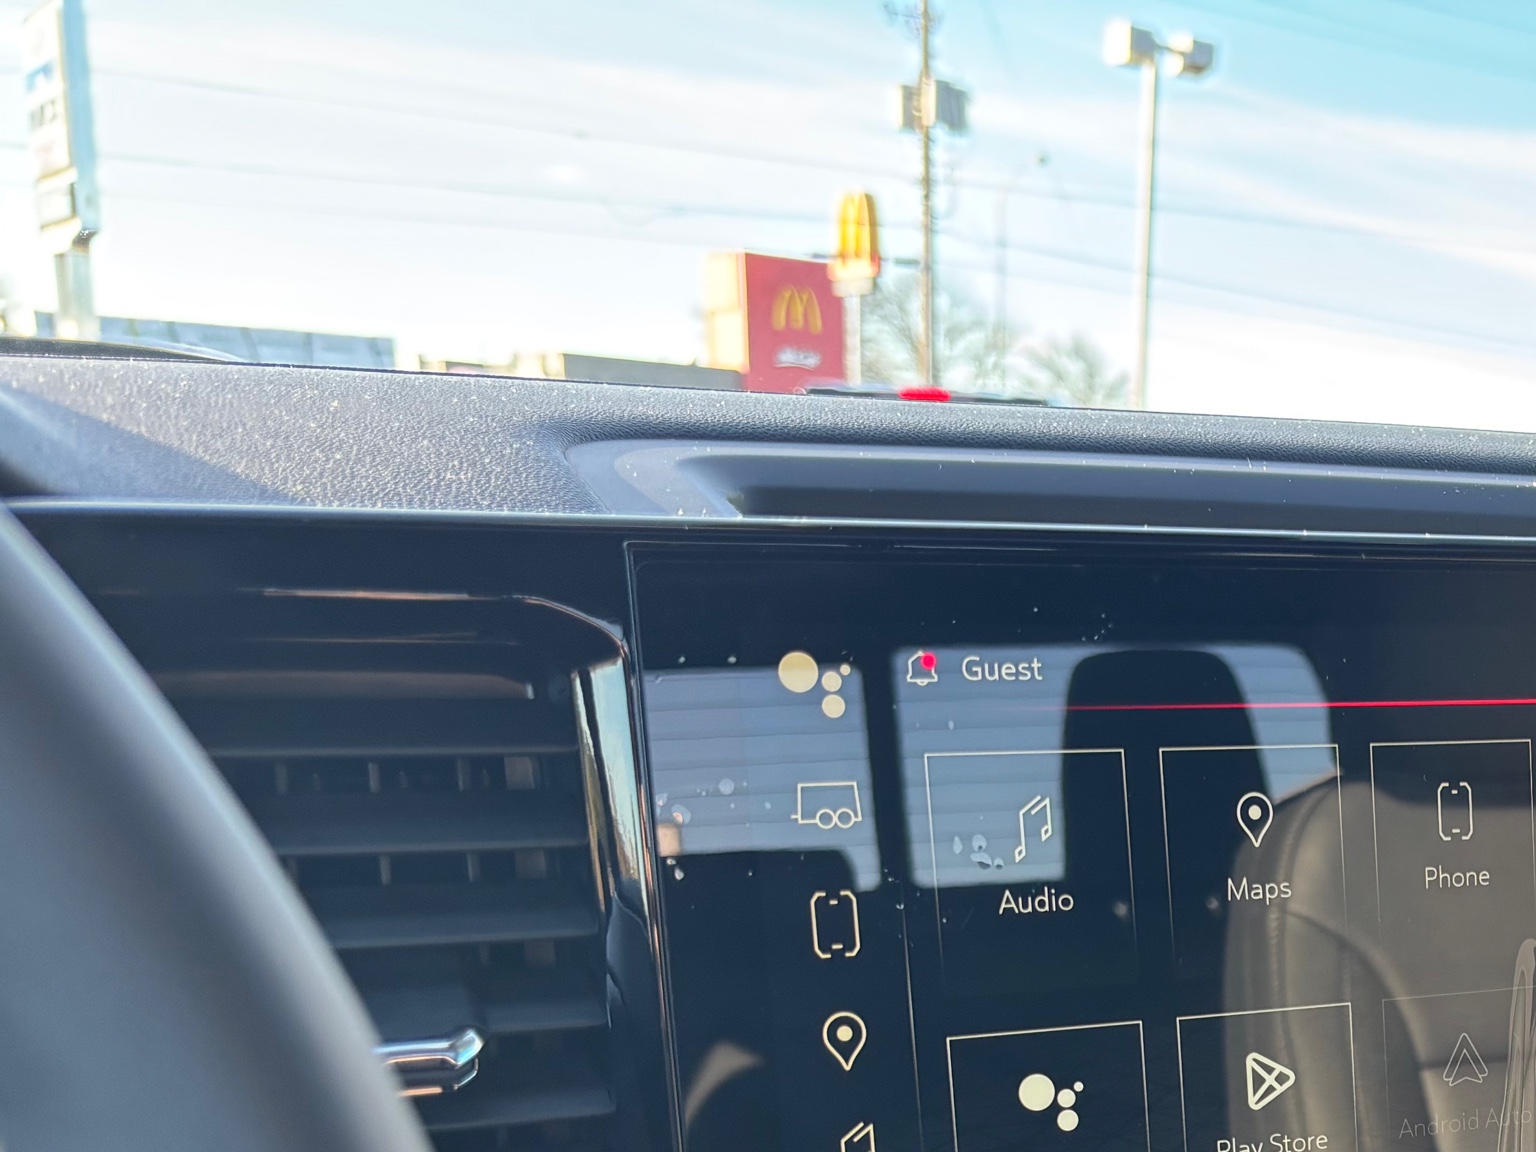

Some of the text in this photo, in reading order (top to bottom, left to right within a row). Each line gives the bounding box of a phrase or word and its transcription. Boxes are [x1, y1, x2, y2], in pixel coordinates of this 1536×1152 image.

[961, 656, 1043, 683] Guest
[1226, 877, 1293, 902] Maps
[1424, 865, 1491, 890] Phone
[999, 889, 1075, 915] Audio
[1399, 1109, 1480, 1139] Android
